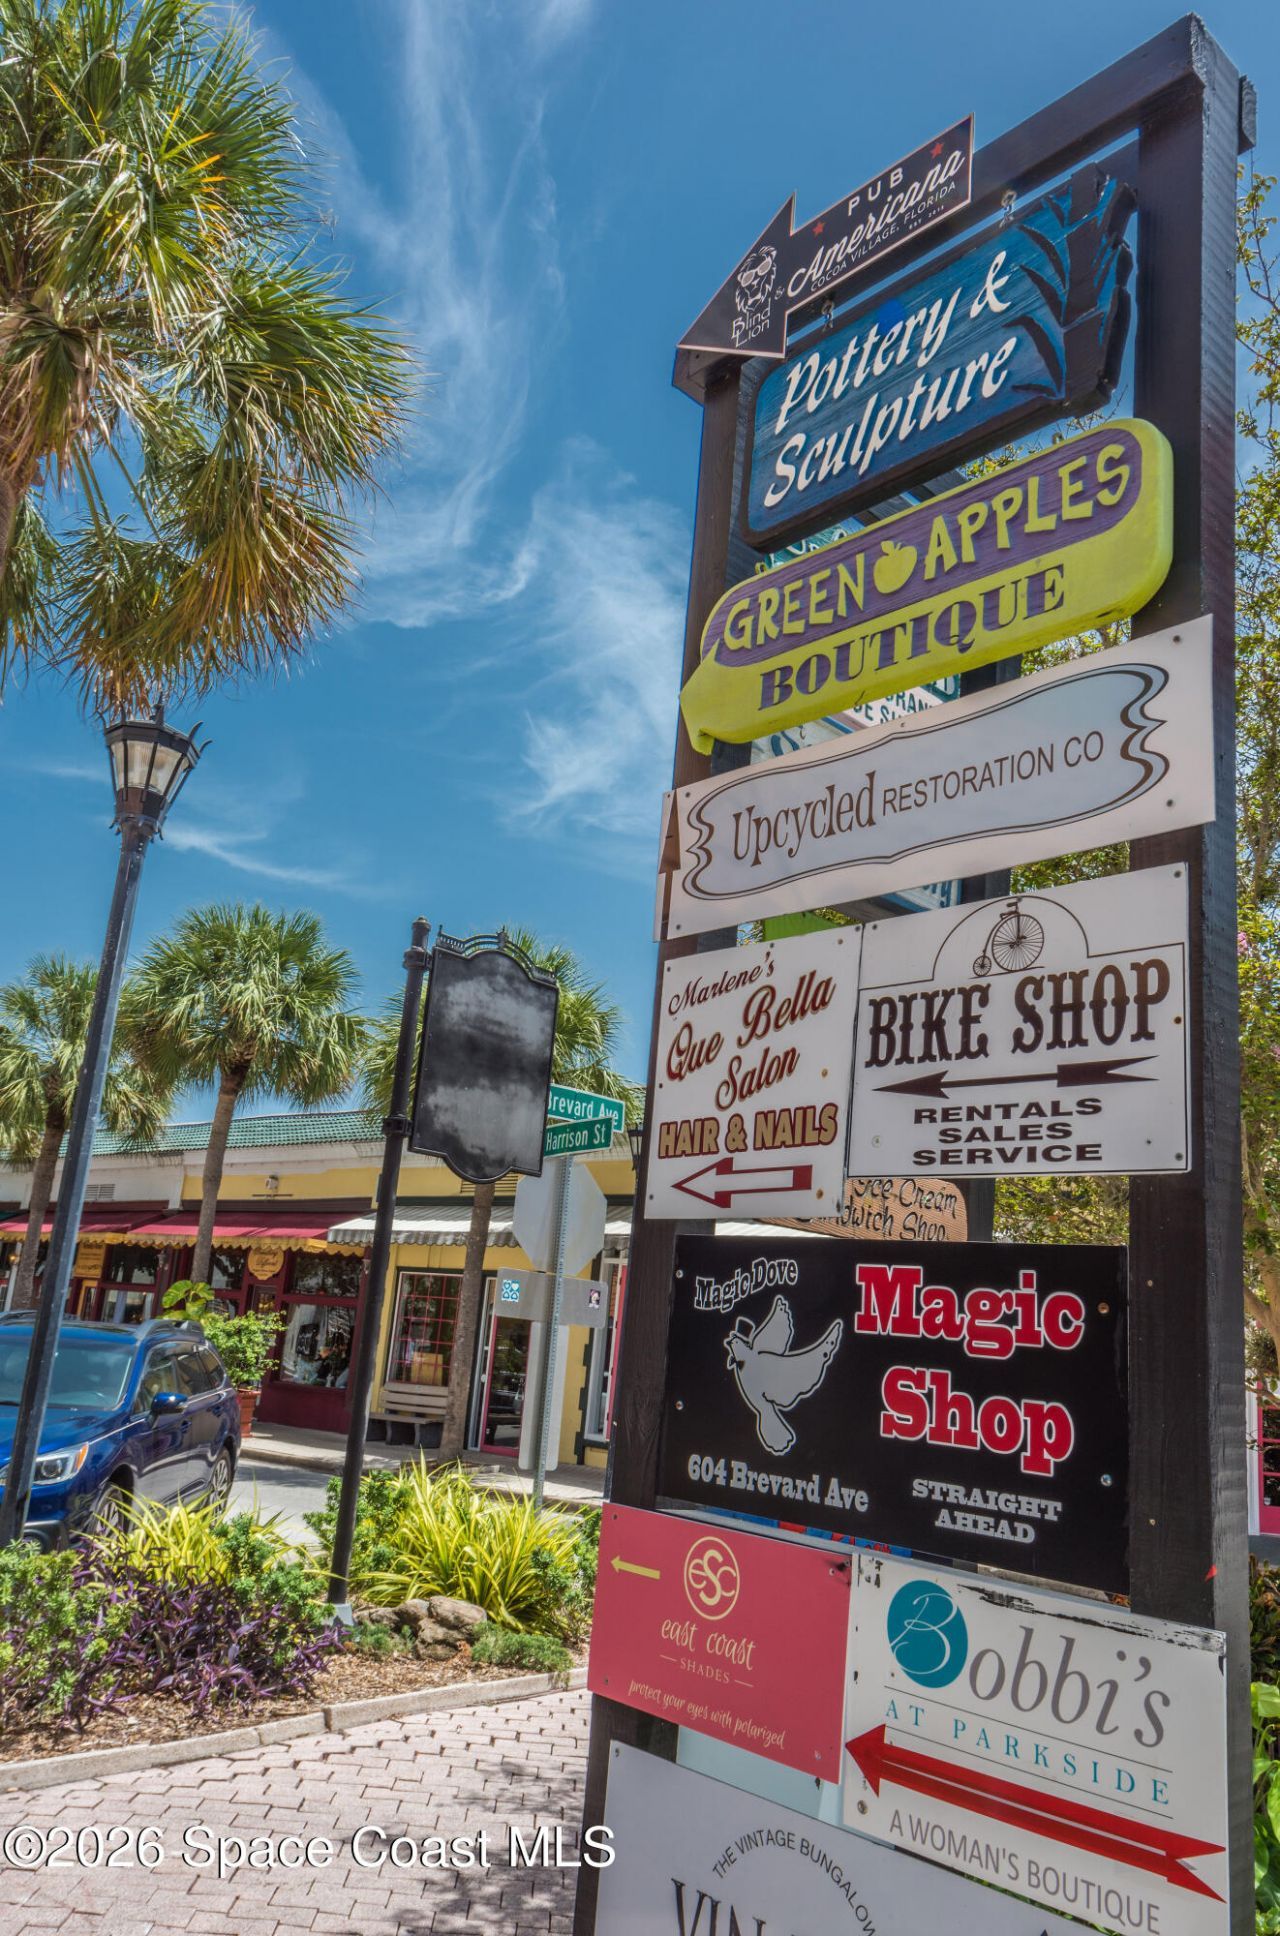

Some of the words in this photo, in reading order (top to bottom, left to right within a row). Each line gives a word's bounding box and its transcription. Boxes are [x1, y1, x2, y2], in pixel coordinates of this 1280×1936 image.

[848, 167, 903, 216] PUB
[787, 150, 965, 297] Americana
[811, 261, 847, 292] COCOA
[904, 182, 955, 224] FLORIDA
[731, 297, 771, 339] Blind
[736, 319, 769, 347] Lion
[775, 287, 963, 434] Pottery
[970, 251, 1012, 318] &
[763, 336, 1018, 507] Sculpture
[724, 553, 865, 650] GREEN
[924, 444, 1131, 580] APPLES
[758, 564, 1066, 711] BOUTIQUE
[732, 770, 876, 867] Upcycled
[883, 743, 1054, 816] RESTORATION
[1064, 730, 1104, 767] CO
[668, 951, 775, 1016] Marlene's
[864, 983, 991, 1068] BIKE
[1011, 958, 1171, 1054] SHOP
[666, 1021, 725, 1083] Que
[737, 970, 837, 1049] Bella
[715, 1046, 801, 1112] Salon
[546, 1129, 588, 1151] Harrison
[593, 1124, 606, 1145] St
[658, 1117, 720, 1159] HAIR
[725, 1113, 748, 1153] &
[753, 1102, 839, 1151] NAILS
[913, 1098, 1102, 1125] RENTALS
[938, 1122, 1073, 1144] SALES
[912, 1143, 1103, 1166] SERVICE
[899, 1178, 958, 1218] Cream
[900, 1212, 946, 1242] Shop
[694, 1268, 750, 1313] Magic
[751, 1257, 798, 1294] Dove
[854, 1264, 1085, 1359] Magic
[880, 1365, 1075, 1478] Shop
[688, 1453, 727, 1485] 604
[730, 1460, 821, 1504] Brevard
[824, 1478, 869, 1512] Ave
[912, 1479, 1062, 1523] STRAIGHT
[935, 1509, 1036, 1544] AHEAD
[661, 1619, 698, 1652] east
[706, 1631, 756, 1671] coast
[680, 1658, 730, 1684] SHADES
[889, 1593, 1171, 1748] Bobbi's
[628, 1680, 661, 1703] protect
[663, 1693, 686, 1710] your
[687, 1702, 708, 1721] eyes
[710, 1709, 732, 1729] with
[733, 1717, 785, 1750] polarized
[885, 1699, 925, 1727] AT
[953, 1718, 1170, 1805] PARKSIDE
[712, 1846, 738, 1879] THE
[735, 1829, 796, 1855] VINTAGE
[889, 1809, 903, 1837] A
[908, 1814, 1020, 1881] WOMAN'S
[1027, 1859, 1160, 1935] BOUTIQUE
